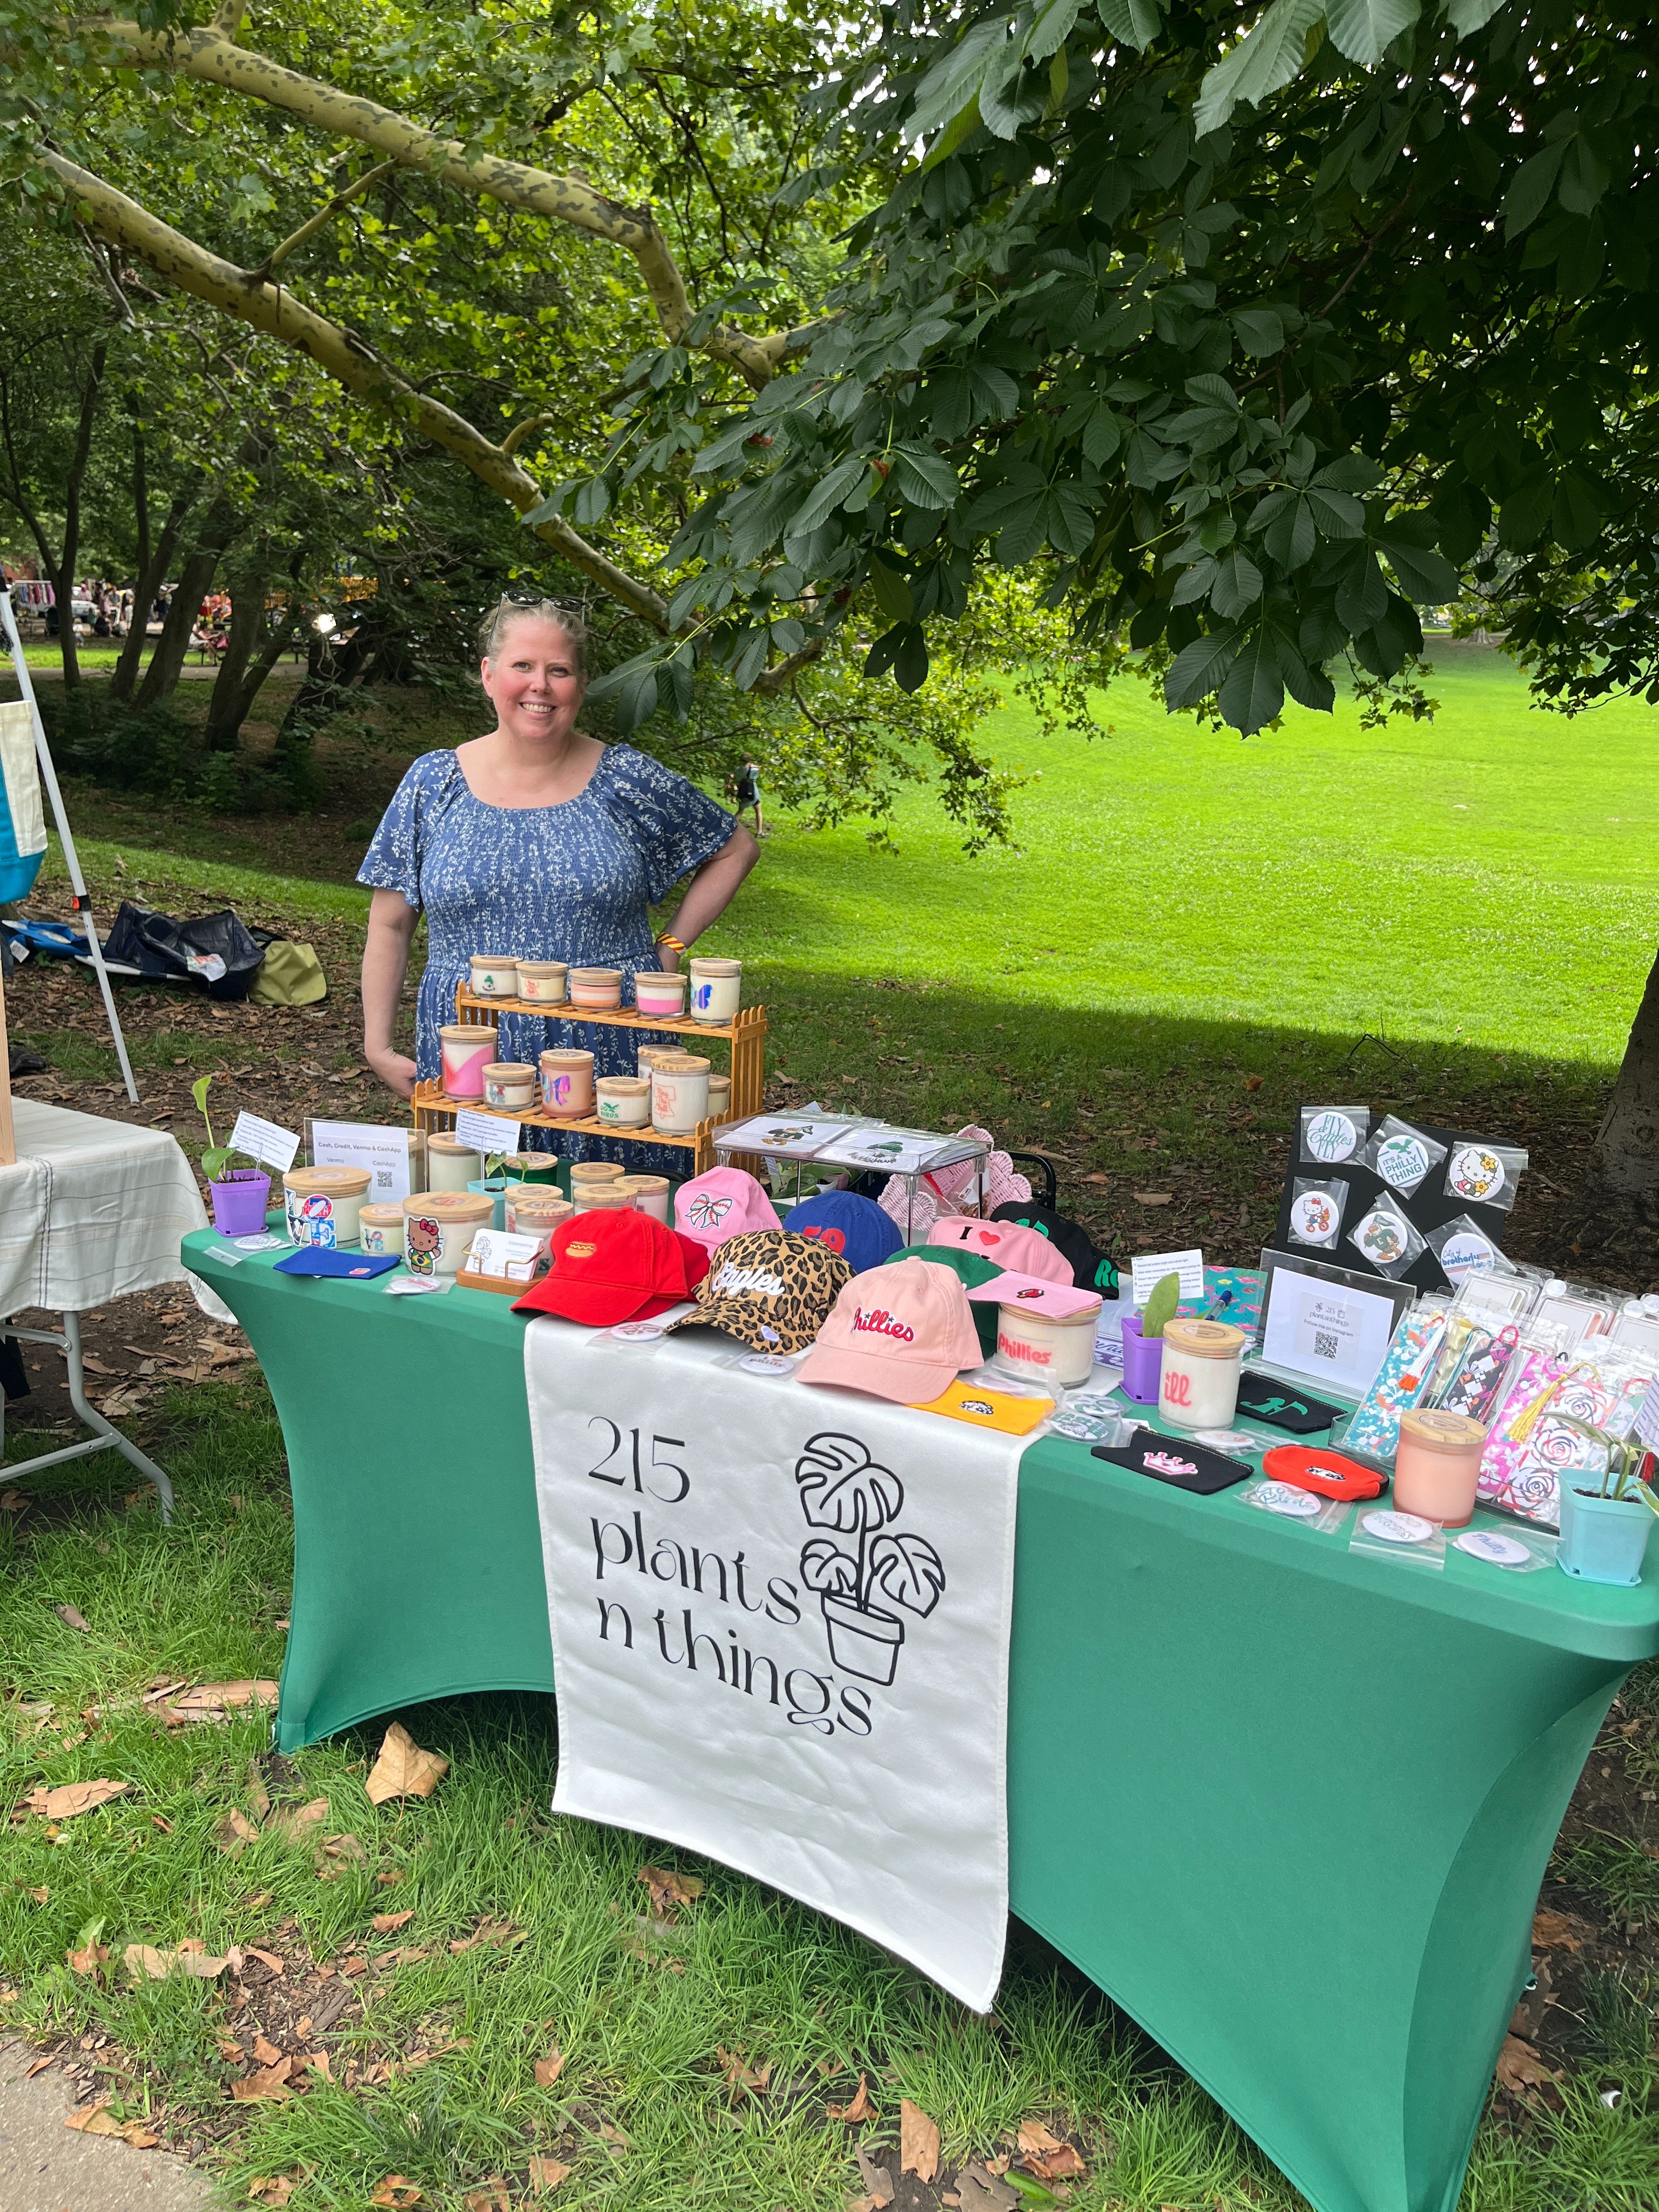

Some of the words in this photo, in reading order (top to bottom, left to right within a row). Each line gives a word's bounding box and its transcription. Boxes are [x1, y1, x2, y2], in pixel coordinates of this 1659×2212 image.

[1323, 1114, 1347, 1136] FLY
[1316, 1139, 1339, 1160] FLY
[1383, 1156, 1396, 1166] IT'S
[1385, 1154, 1417, 1175] PHILLY
[1388, 1163, 1423, 1183] THING
[959, 1226, 974, 1240] I
[1443, 1249, 1455, 1259] City
[1456, 1248, 1462, 1257] of
[712, 1261, 786, 1296] Eagles
[1309, 1311, 1350, 1328] plantsnthings
[1325, 1306, 1336, 1314] 215
[1304, 1318, 1318, 1327] Follow
[1331, 1327, 1353, 1338] Instagram
[998, 1332, 1053, 1364] Phillies
[1164, 1370, 1192, 1407] ill
[588, 1416, 690, 1503] 215
[1259, 1492, 1316, 1510] Birds
[590, 1511, 802, 1625] plants
[598, 1596, 634, 1649] n
[653, 1609, 873, 1736] things
